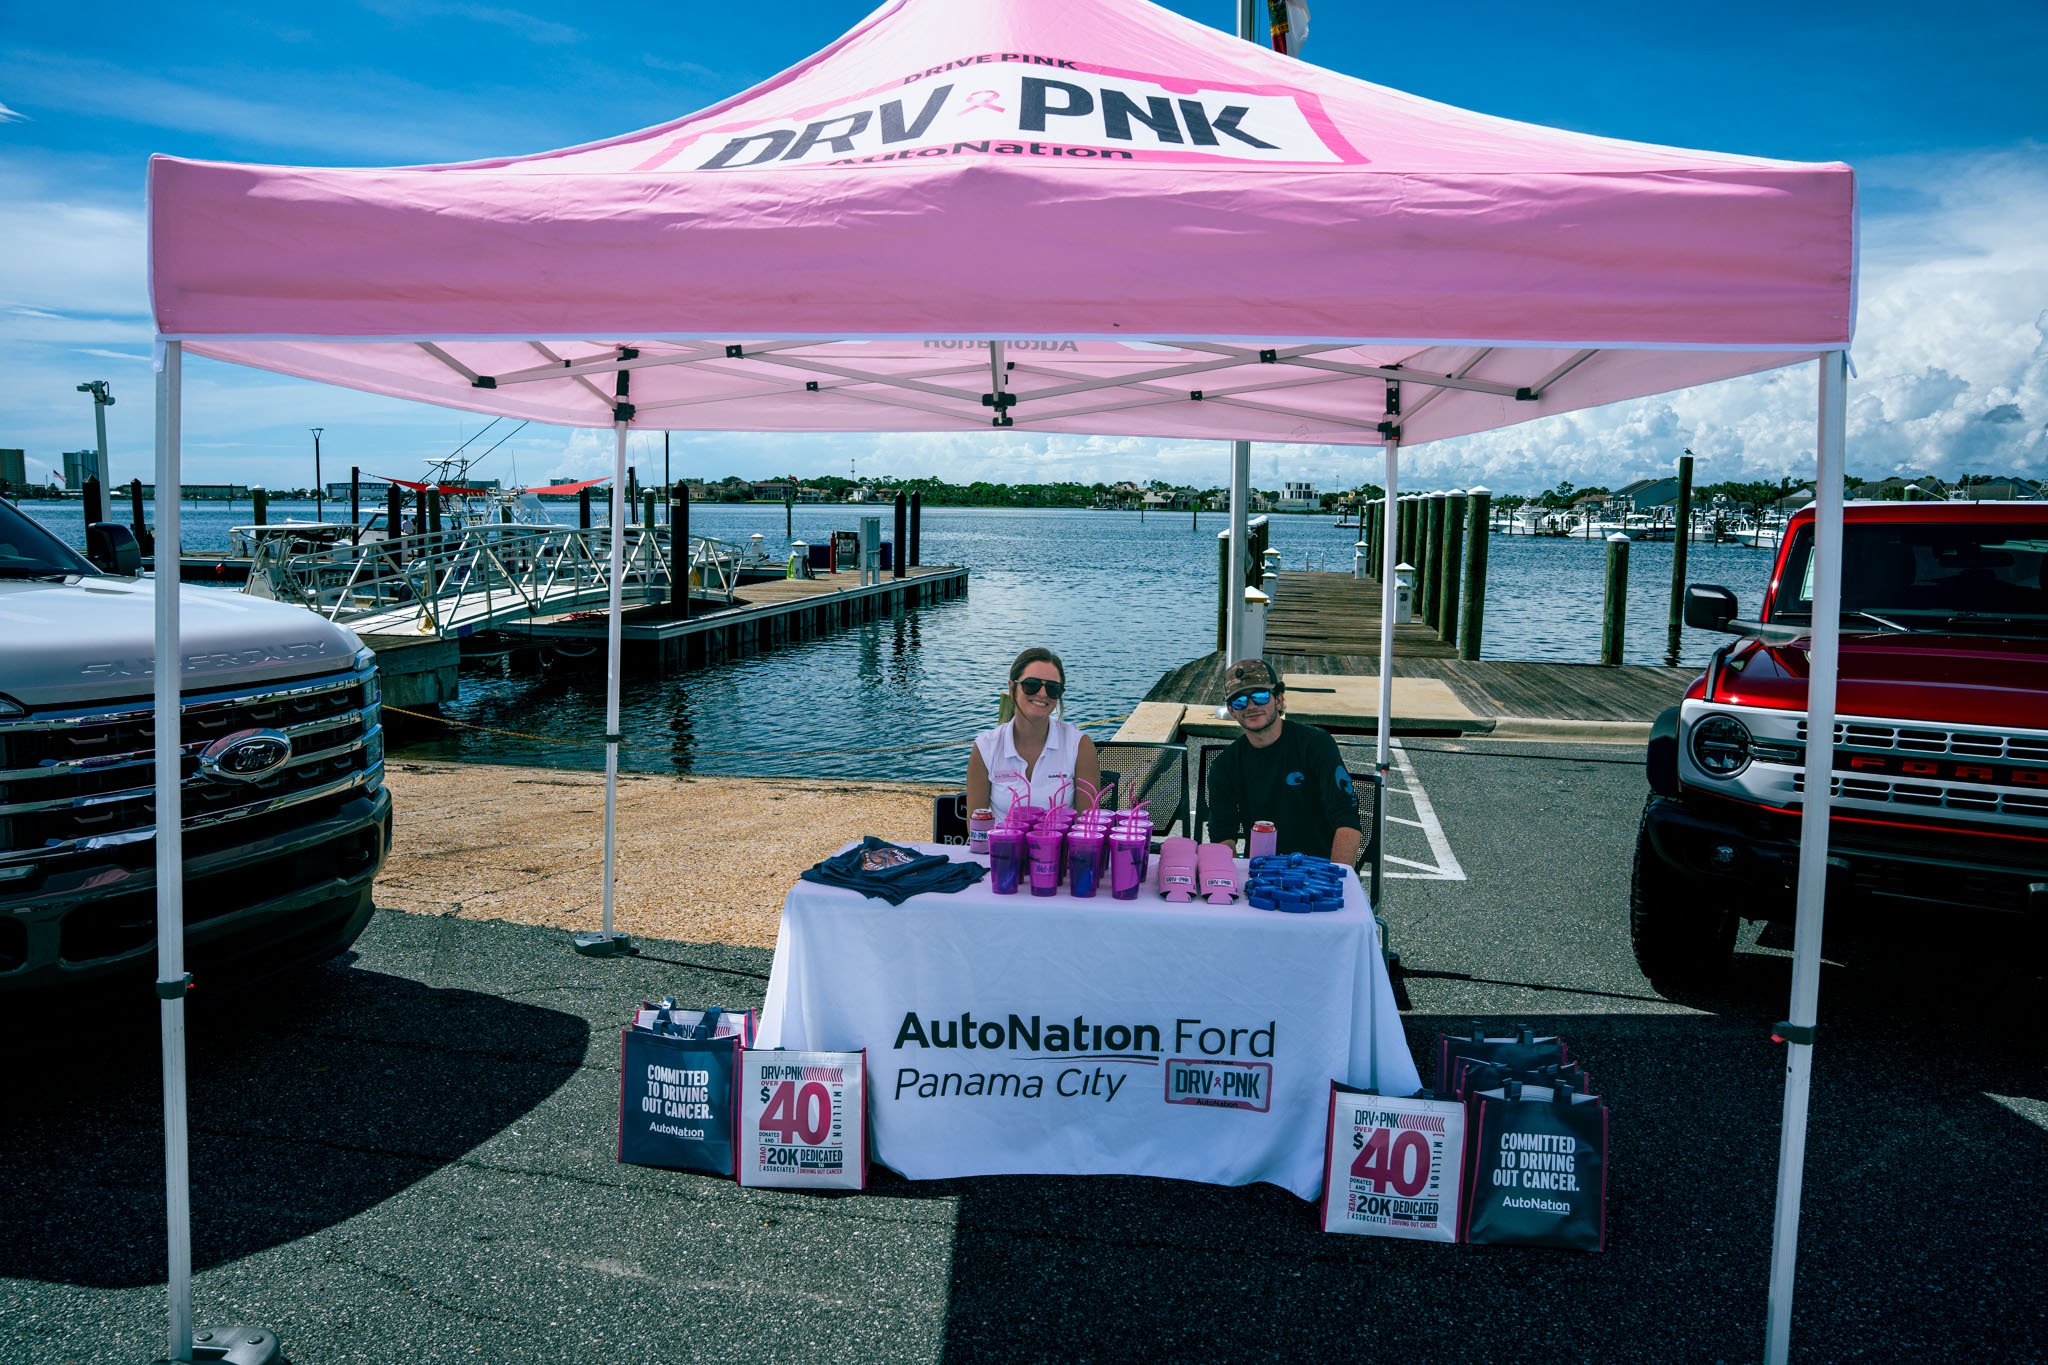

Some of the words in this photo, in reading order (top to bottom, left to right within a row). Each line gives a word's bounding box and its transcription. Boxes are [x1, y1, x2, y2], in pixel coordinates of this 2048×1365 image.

[904, 53, 992, 84] DRIVE
[1000, 52, 1078, 70] PINK
[695, 84, 955, 170] DRV
[1018, 77, 1282, 149] PNK
[829, 141, 1133, 166] AutoNation
[235, 744, 275, 770] Ford
[893, 1011, 1160, 1051] AutoNation
[1175, 1018, 1276, 1057] Ford
[647, 1064, 709, 1086] COMMITTED
[761, 1066, 780, 1080] DRV
[785, 1066, 803, 1080] PNK
[1176, 1069, 1214, 1095] DRV
[1223, 1071, 1260, 1099] PNK
[647, 1080, 660, 1098] TO
[662, 1083, 708, 1103] DRIVING
[895, 1068, 1043, 1100] Panama
[1056, 1067, 1128, 1102] City
[642, 1096, 662, 1114] OUT
[664, 1099, 714, 1120] CANCER.
[1196, 1099, 1238, 1109] AutoNation
[649, 1121, 705, 1138] AutoNation
[1354, 1109, 1374, 1127] DRV
[1379, 1111, 1400, 1128] PNK
[1501, 1133, 1576, 1153] COMMITTED
[767, 1147, 799, 1166] 20K
[801, 1148, 843, 1162] DEDICATED
[1500, 1151, 1515, 1168] TO
[1519, 1153, 1575, 1173] DRIVING
[1350, 1177, 1372, 1186] DONATED
[1493, 1169, 1518, 1187] OUT
[1522, 1171, 1580, 1192] CANCER.
[1357, 1195, 1391, 1217] 20K
[1393, 1199, 1439, 1215] DEDICATED
[1502, 1196, 1571, 1212] AutoNation
